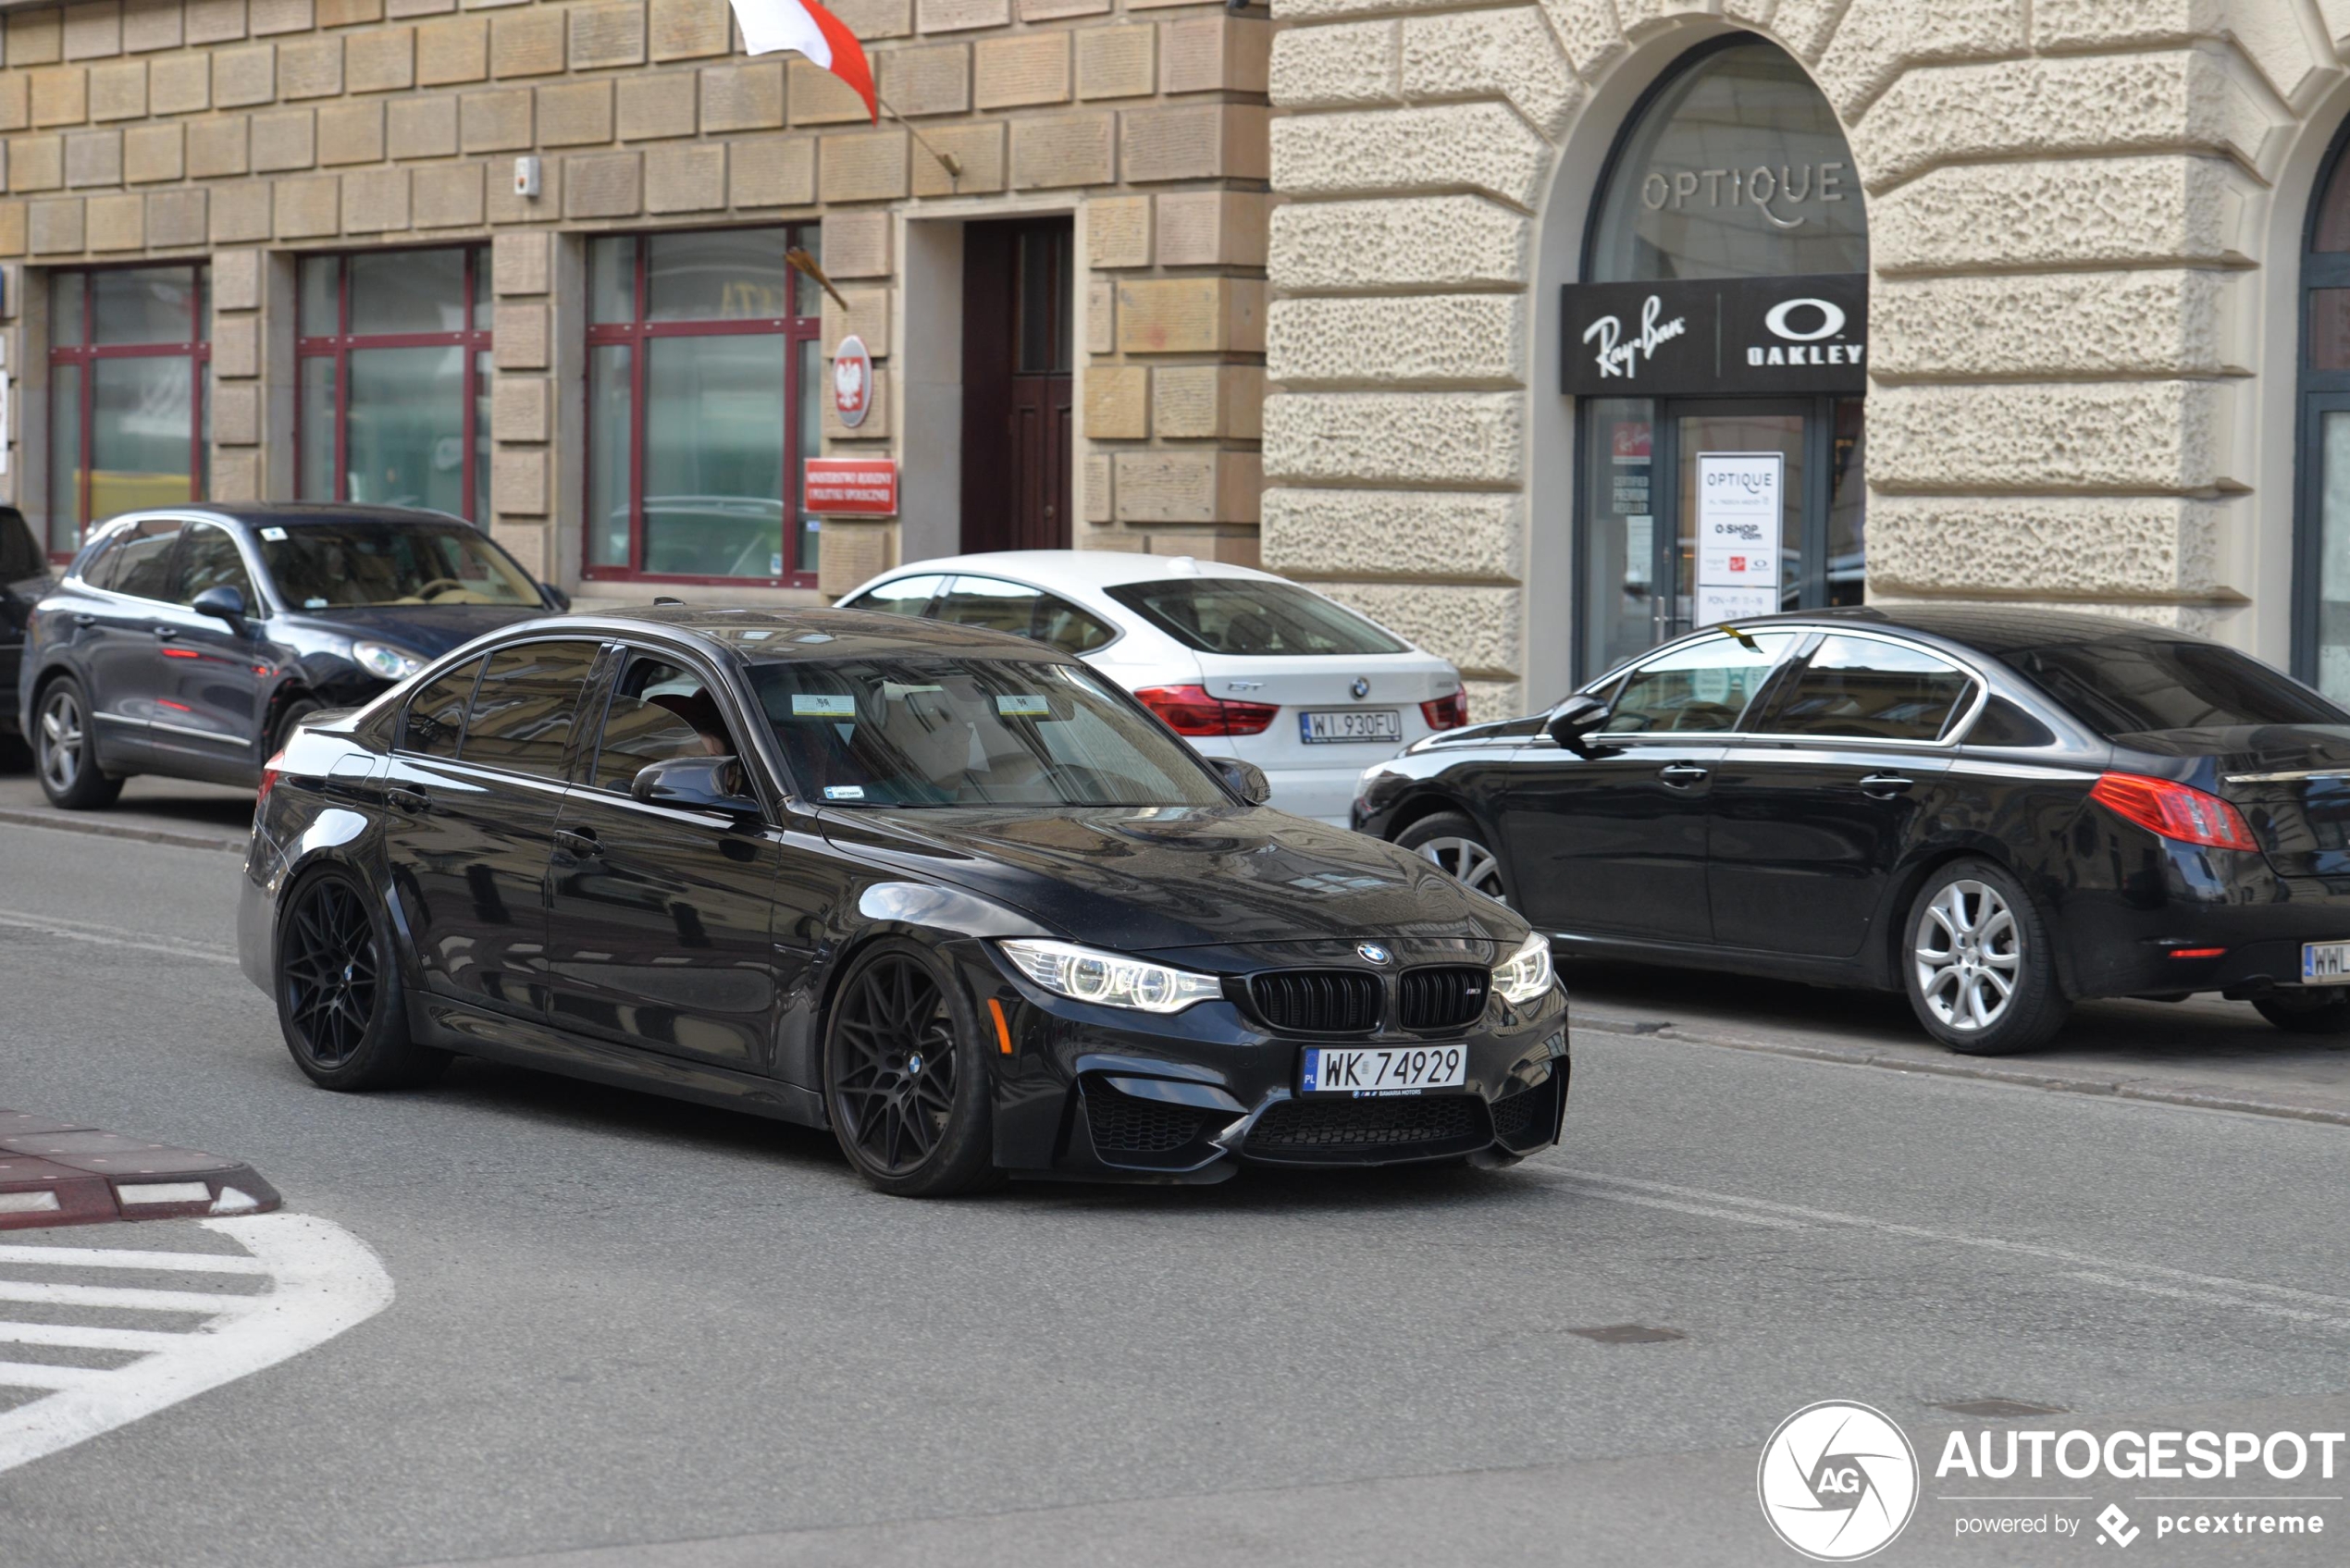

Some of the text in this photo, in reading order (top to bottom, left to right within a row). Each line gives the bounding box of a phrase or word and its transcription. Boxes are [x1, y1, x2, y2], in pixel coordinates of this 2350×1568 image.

[1640, 162, 1845, 229] OPTIQUE
[1747, 344, 1864, 366] OAKLEY
[1707, 473, 1773, 495] OPTIQUE
[1312, 714, 1397, 736] WI 930FU
[1305, 1049, 1460, 1087] PL WK 74929
